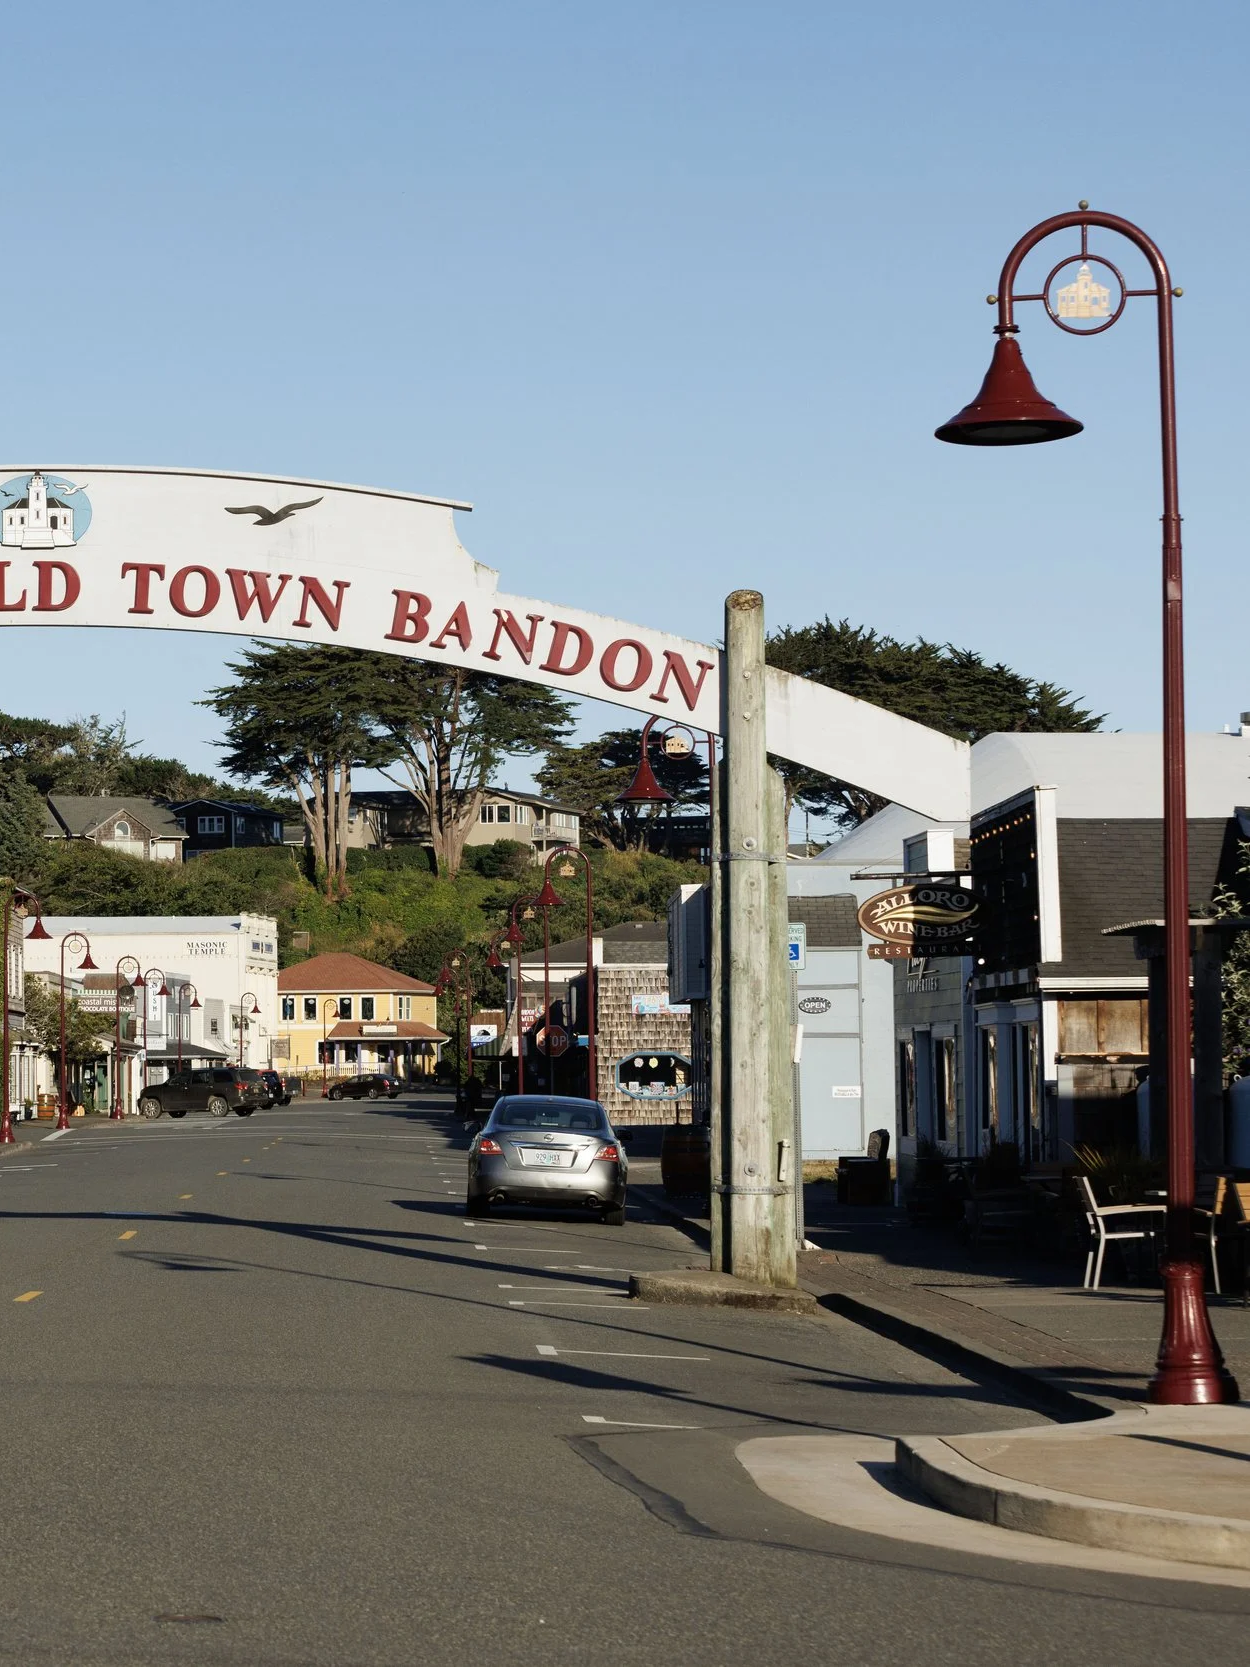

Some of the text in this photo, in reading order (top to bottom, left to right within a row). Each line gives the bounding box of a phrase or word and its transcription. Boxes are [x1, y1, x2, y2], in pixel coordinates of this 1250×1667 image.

[121, 562, 349, 629] TOWN
[388, 590, 712, 708] BANDON
[870, 889, 970, 918] ALLORO
[878, 920, 934, 938] WINE
[186, 941, 228, 949] MASONIC
[874, 944, 982, 955] RESTAURANT
[77, 998, 117, 1006] coastal mis
[804, 1001, 826, 1009] OPEN
[538, 1035, 567, 1047] SOP
